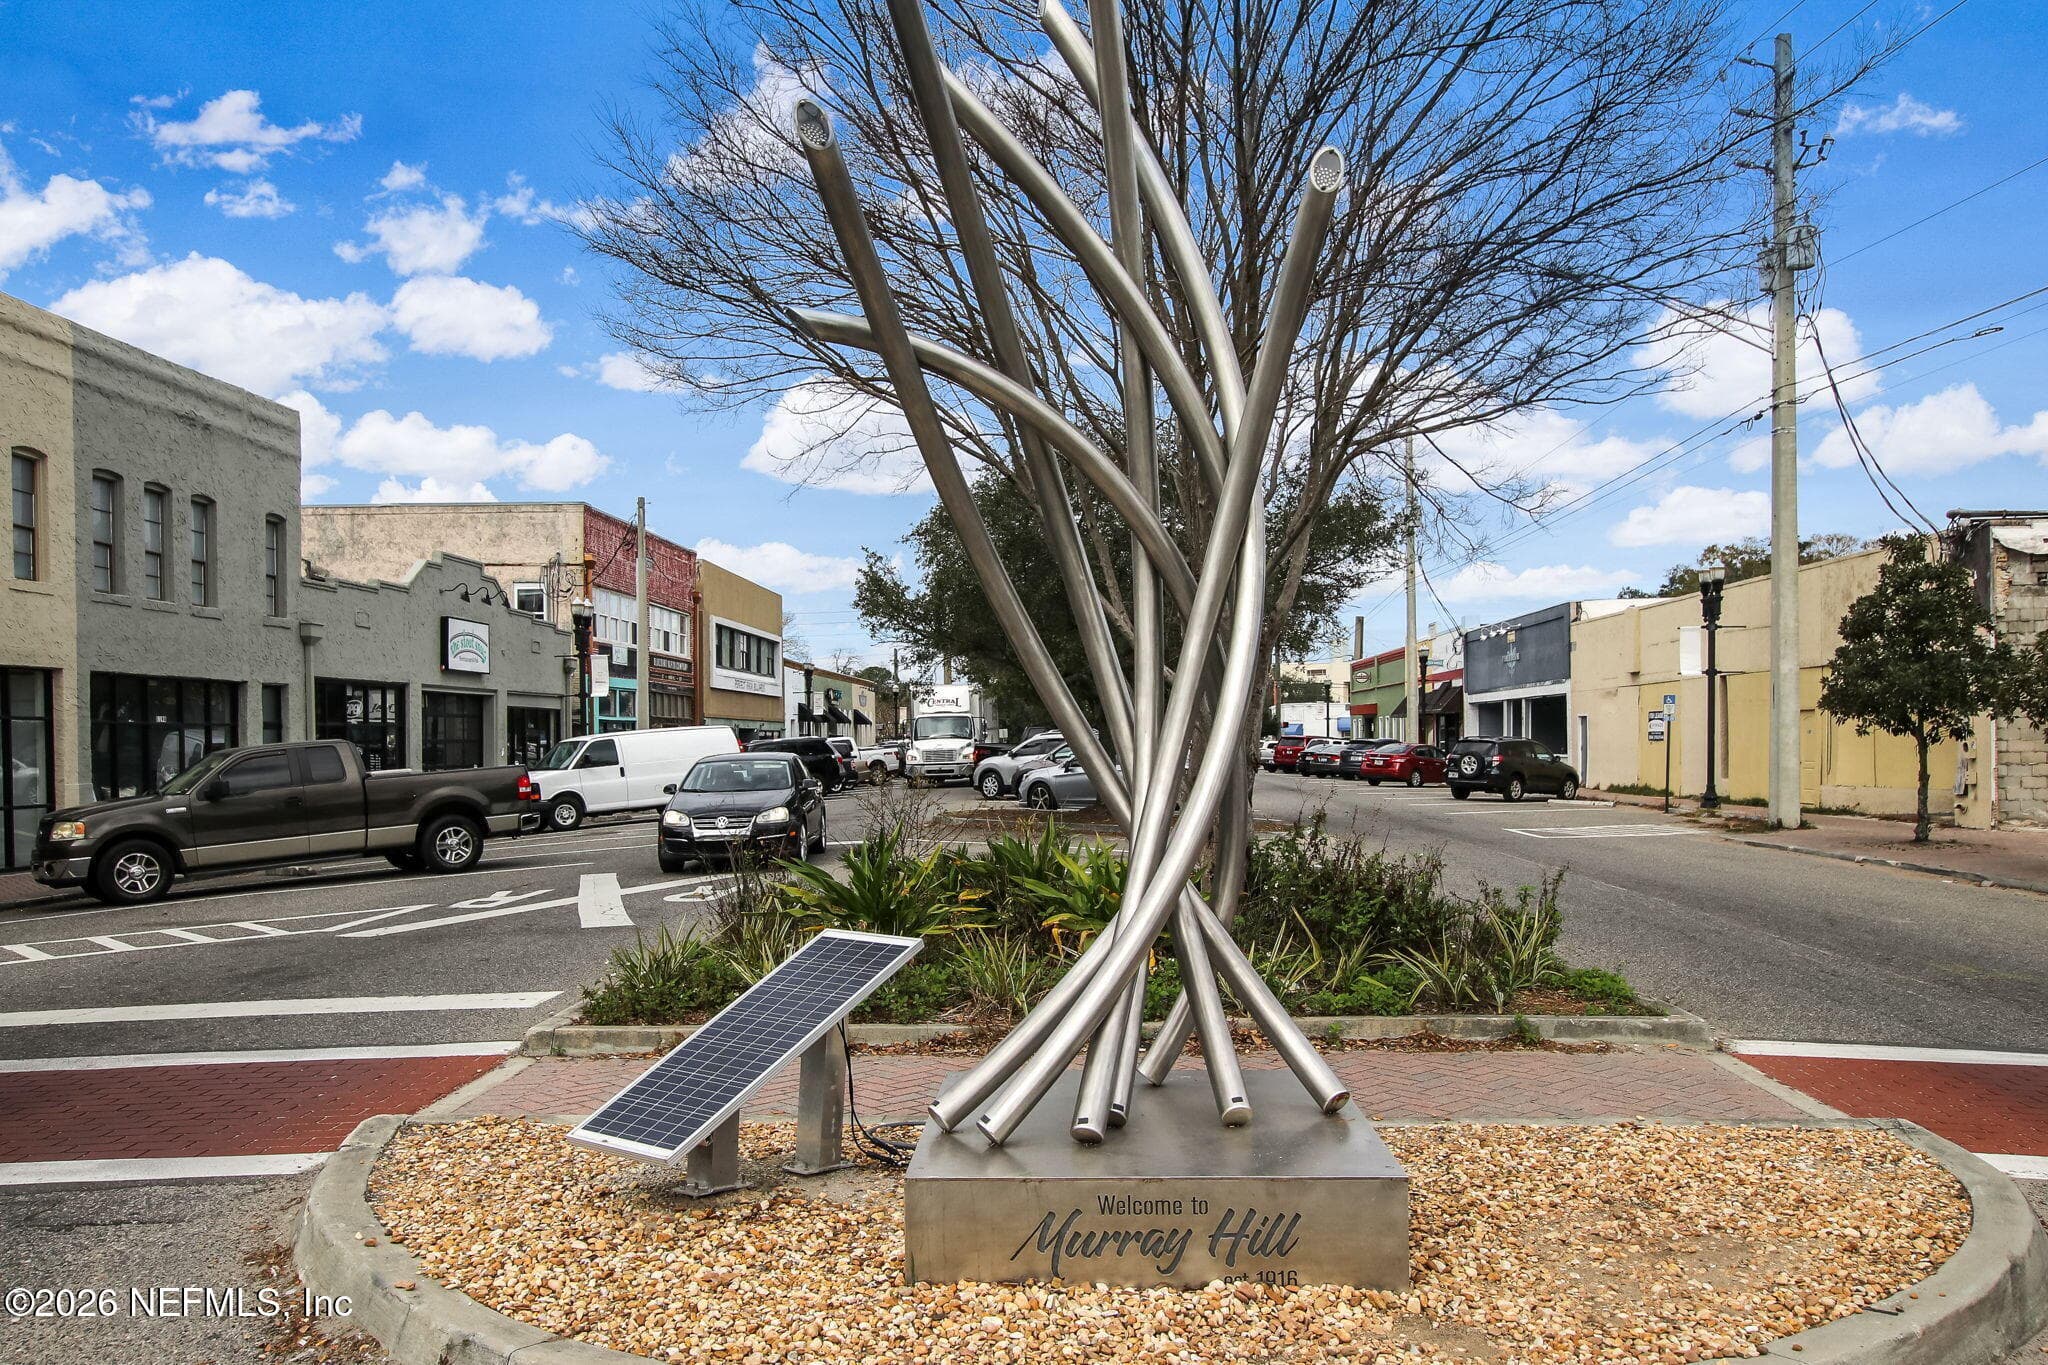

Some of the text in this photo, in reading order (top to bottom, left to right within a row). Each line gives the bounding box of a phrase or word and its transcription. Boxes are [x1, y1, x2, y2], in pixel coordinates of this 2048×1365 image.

[1098, 1195, 1209, 1216] Welcome to
[1010, 1207, 1302, 1281] Murray Hill
[1256, 1270, 1298, 1287] 1916
